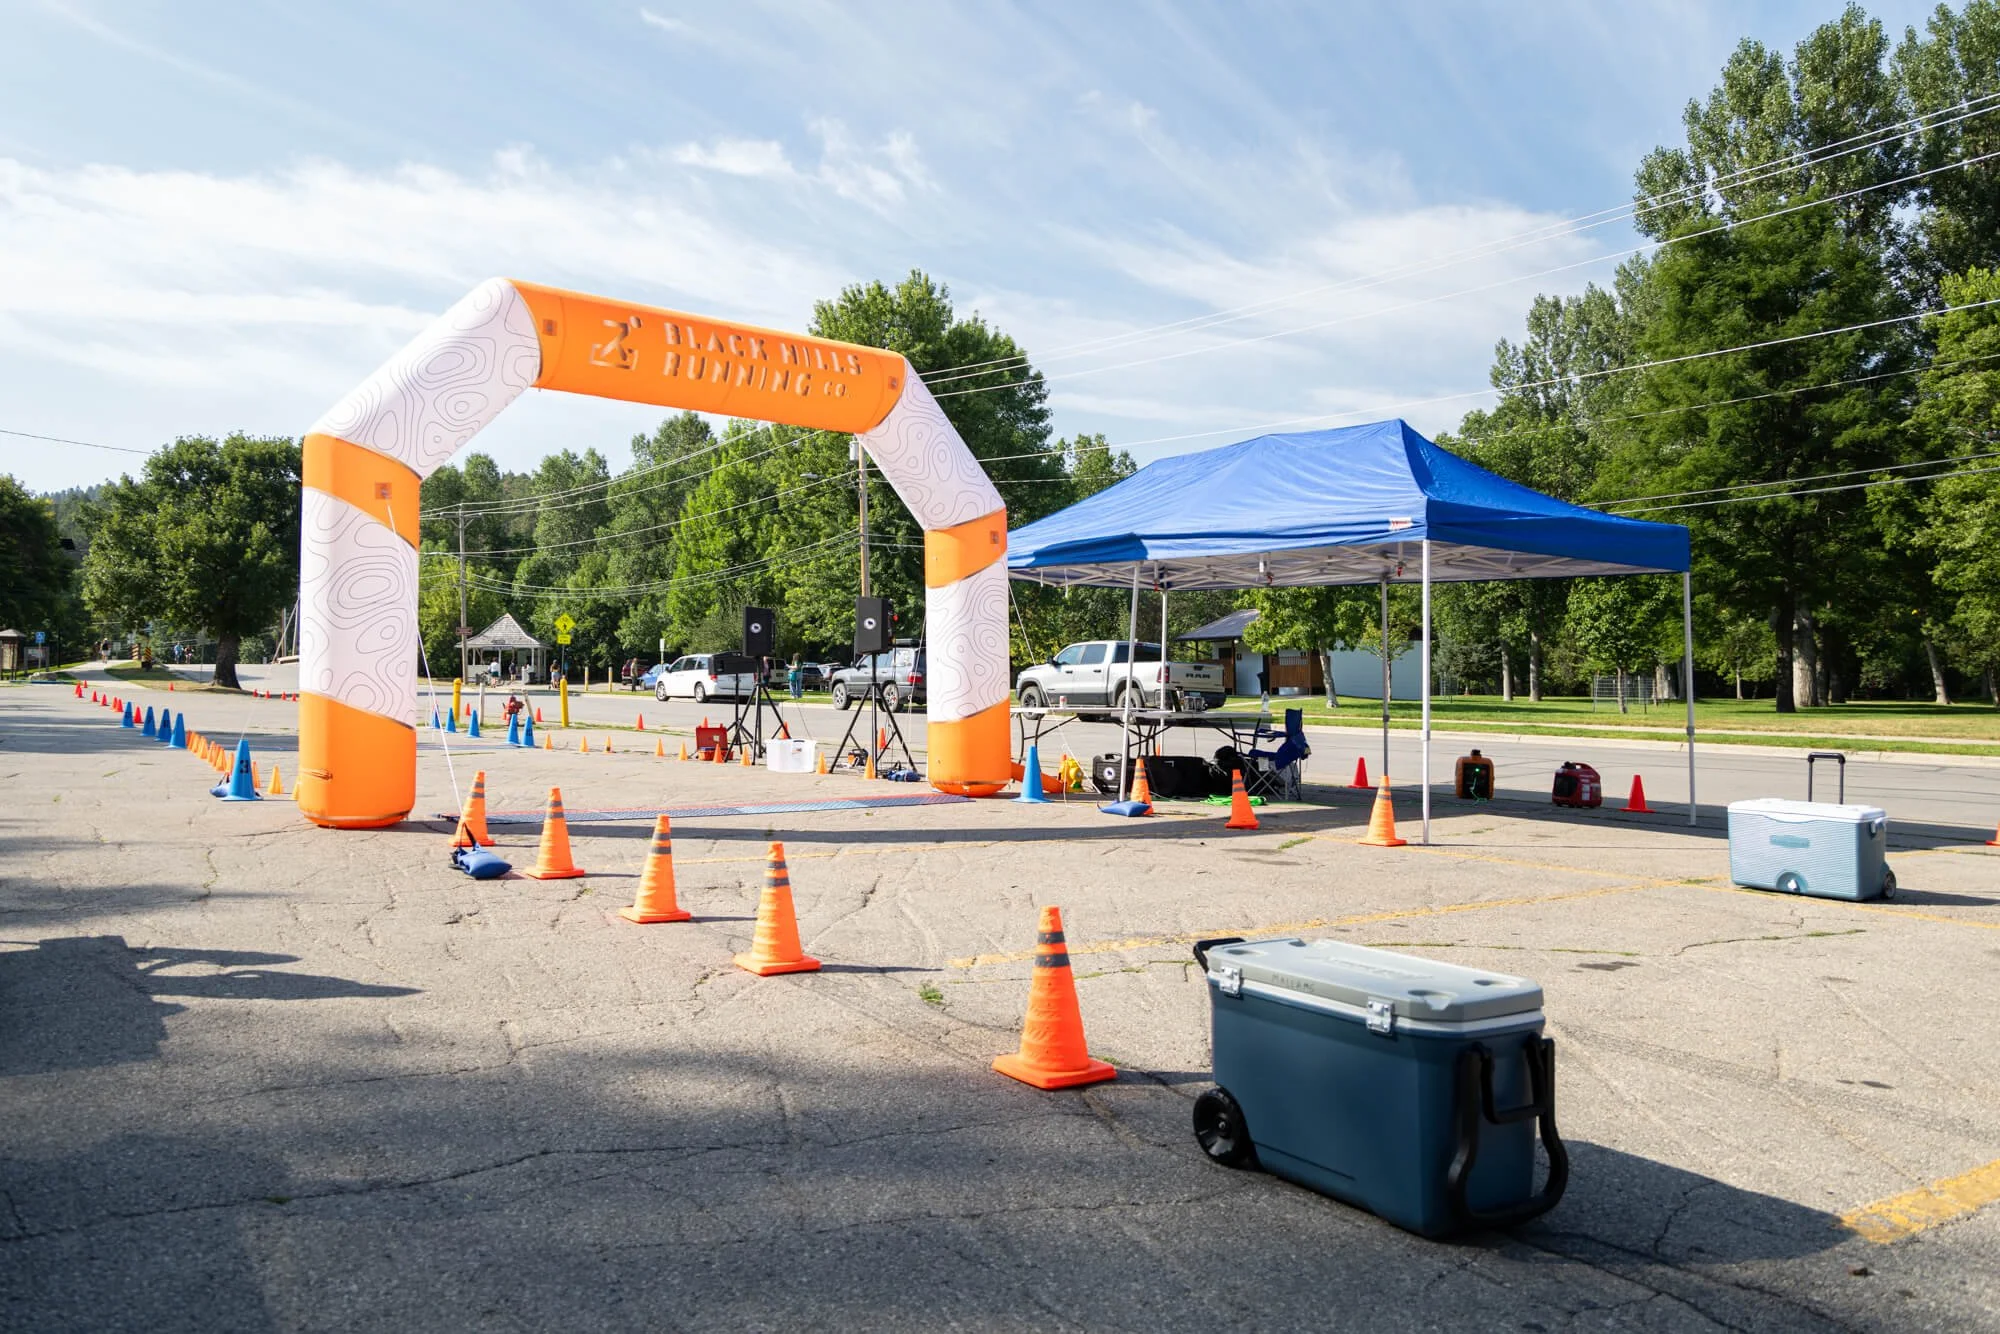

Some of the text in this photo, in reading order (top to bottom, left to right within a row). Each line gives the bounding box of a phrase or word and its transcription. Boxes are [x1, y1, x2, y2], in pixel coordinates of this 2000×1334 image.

[663, 322, 862, 376] BLACK HILLS
[662, 351, 812, 397] RUNNING
[1185, 672, 1211, 680] RAM
